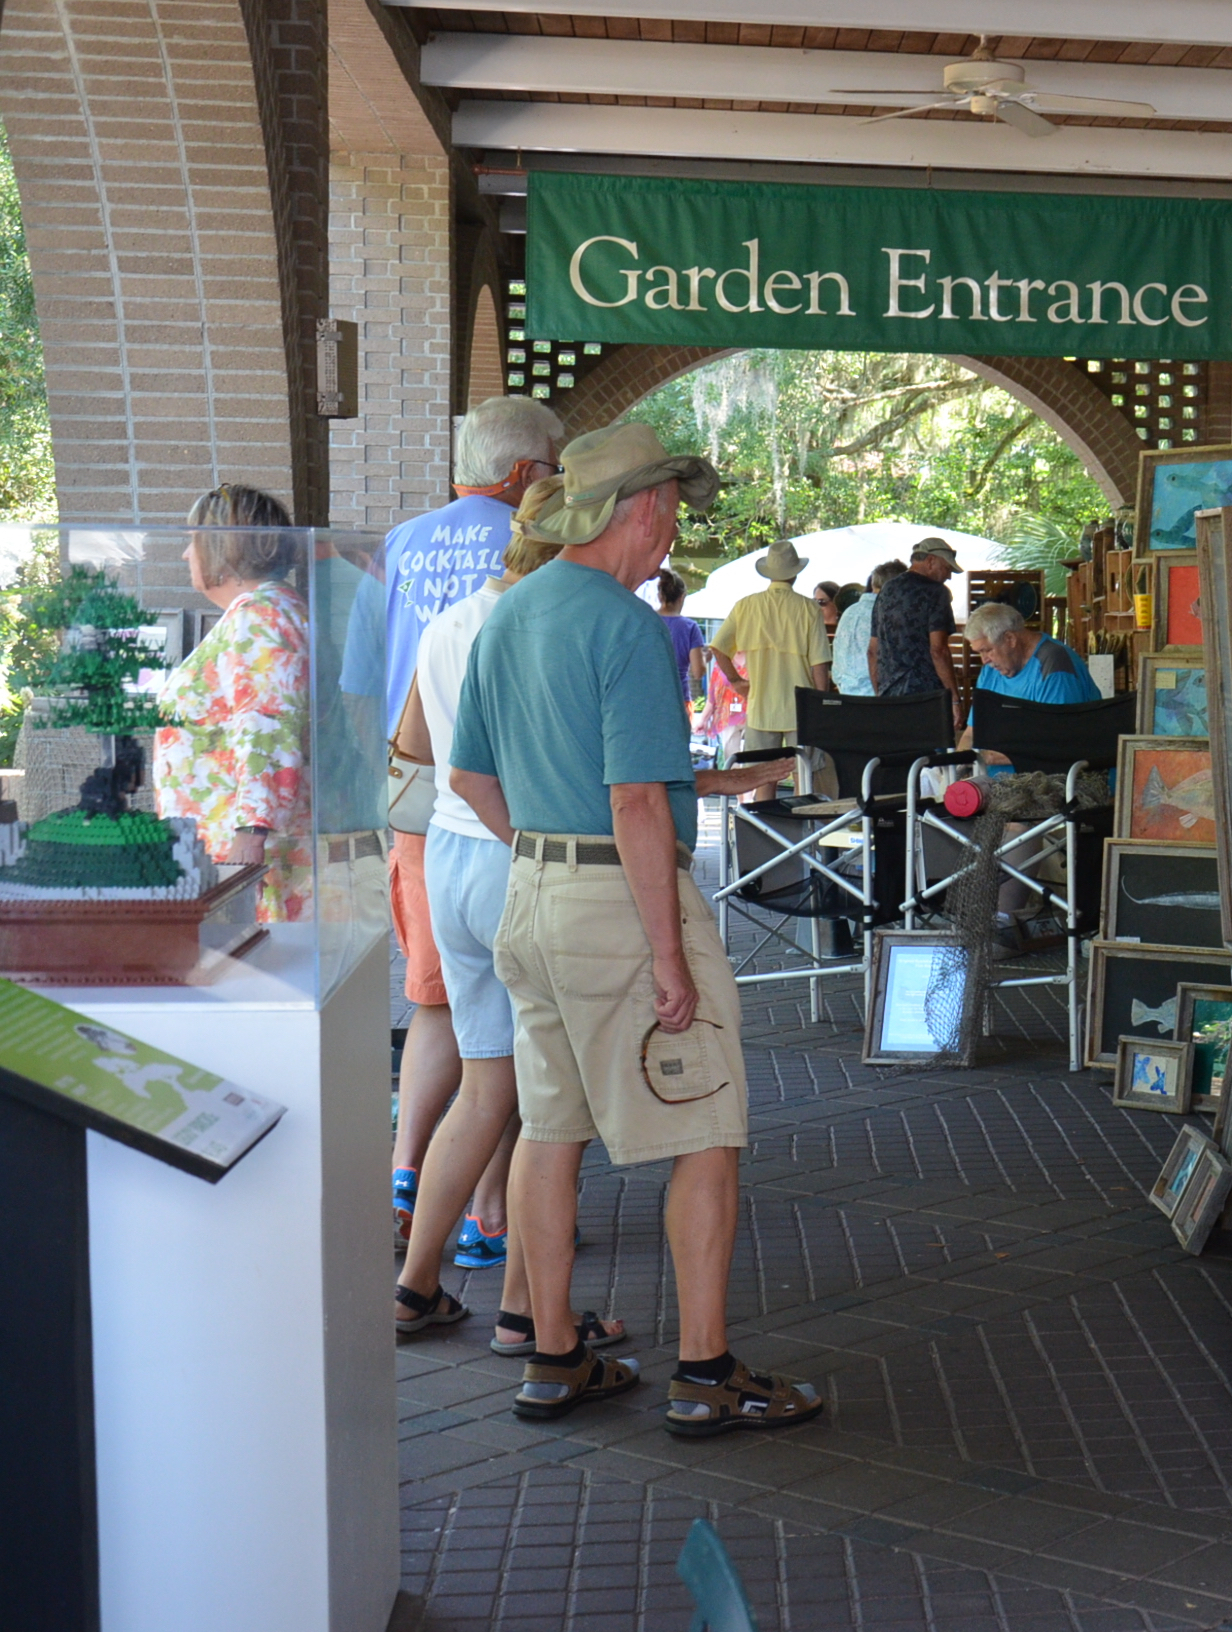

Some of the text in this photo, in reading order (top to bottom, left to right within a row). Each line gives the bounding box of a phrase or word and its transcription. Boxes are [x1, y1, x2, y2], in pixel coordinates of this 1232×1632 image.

[569, 235, 1209, 328] Garden Entrance
[430, 523, 493, 546] MAKE
[423, 573, 479, 599] NOT
